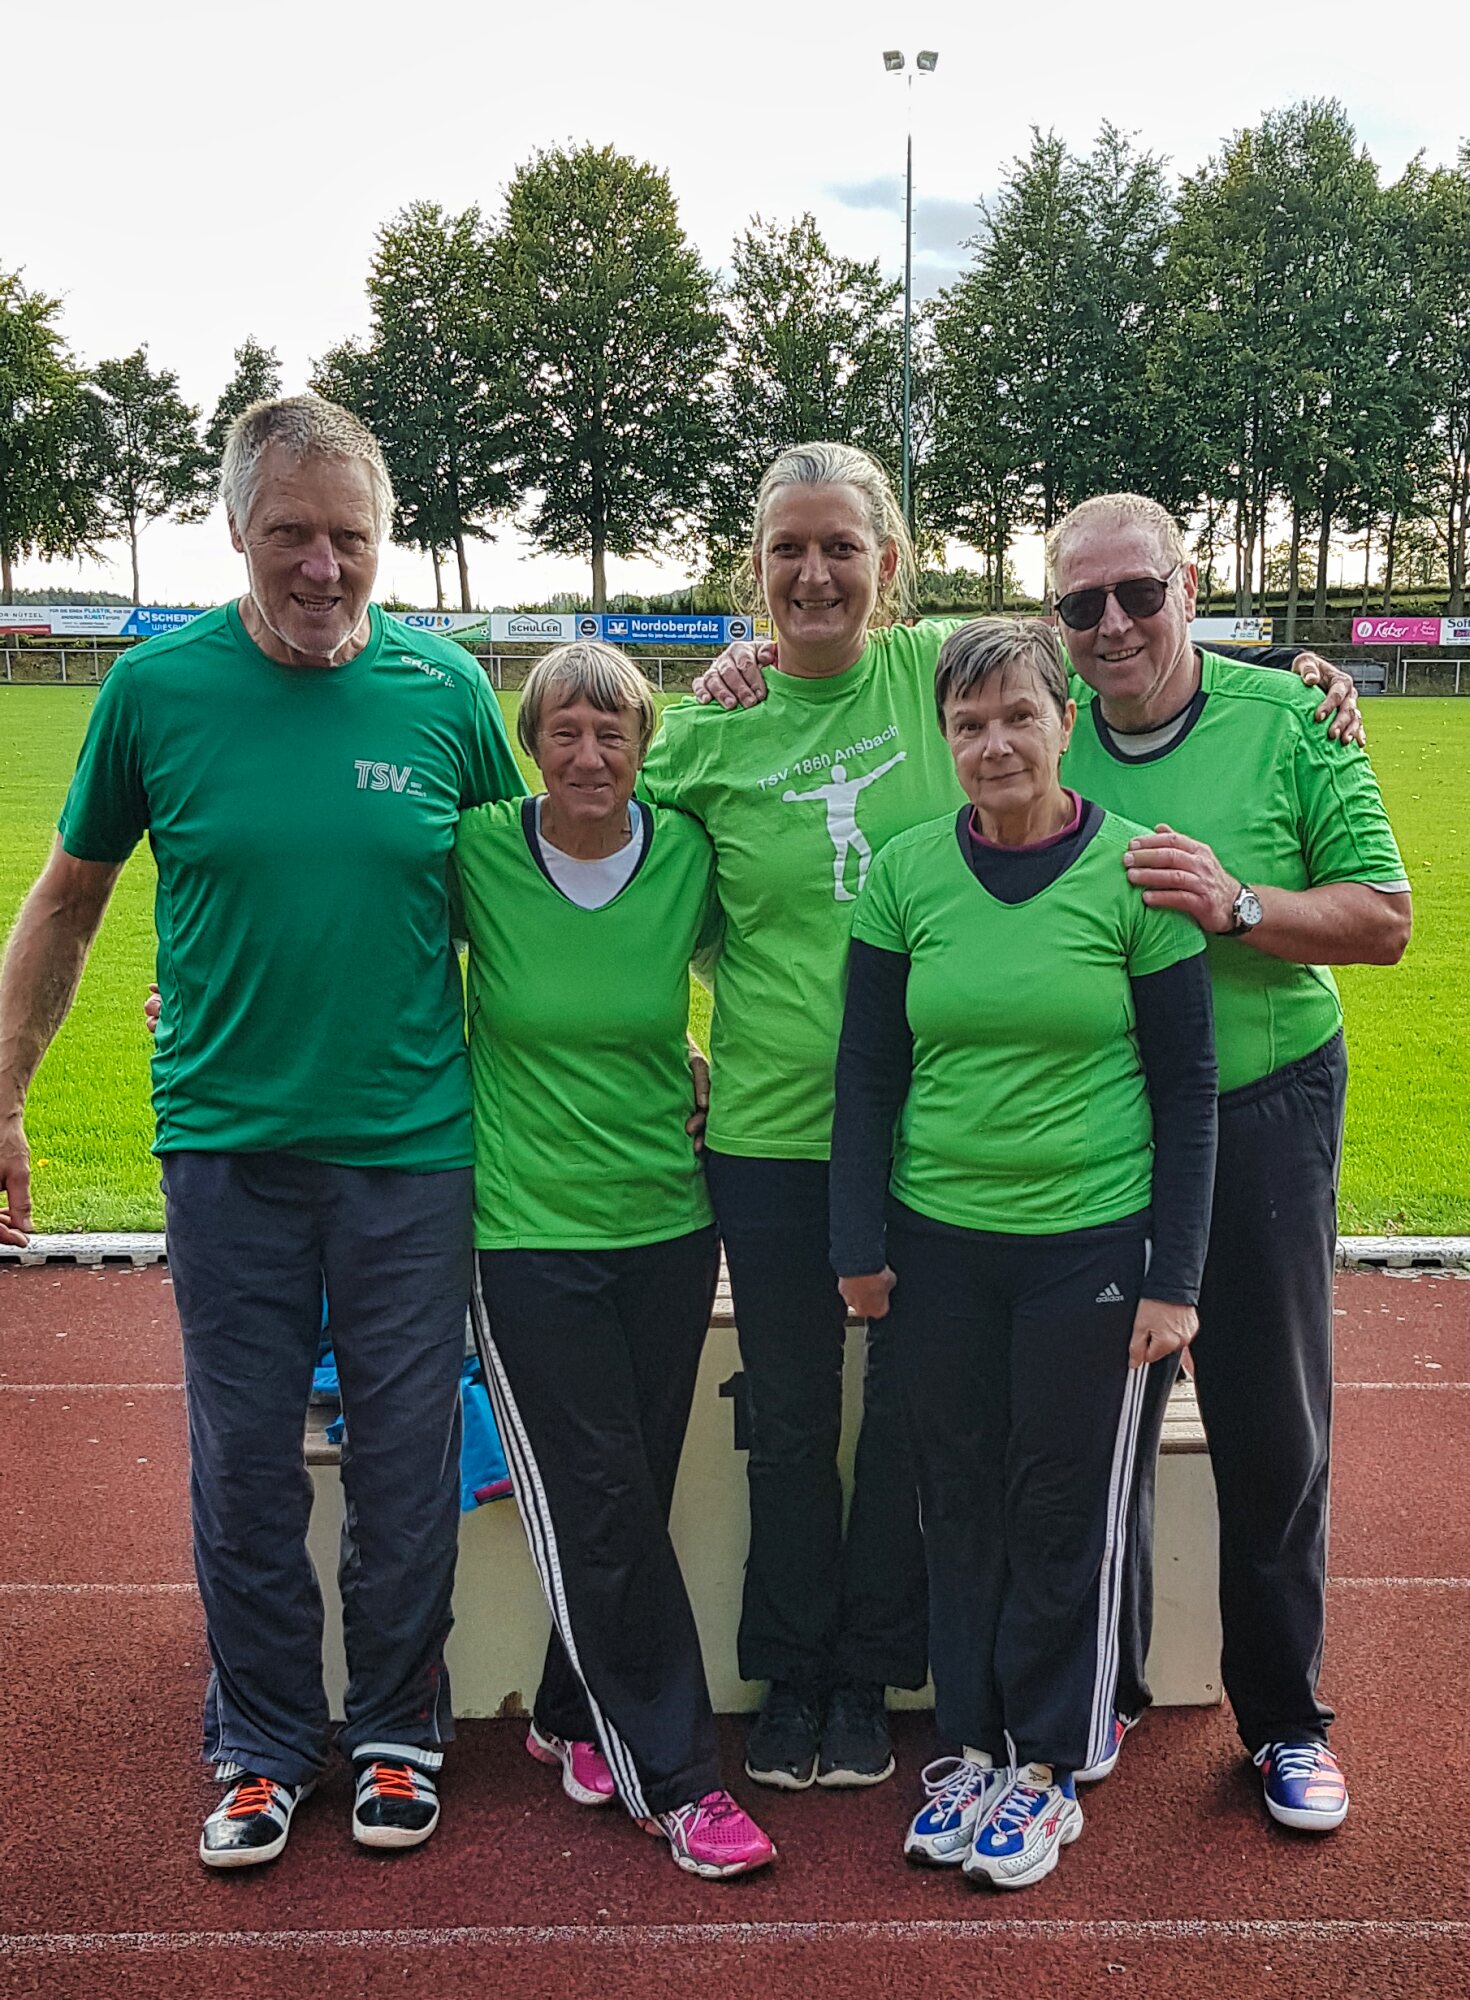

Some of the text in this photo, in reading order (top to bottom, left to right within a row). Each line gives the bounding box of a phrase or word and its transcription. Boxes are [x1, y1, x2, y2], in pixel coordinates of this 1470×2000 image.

[404, 615, 435, 627] CSU
[631, 618, 719, 636] Nordoberpfalz
[400, 655, 447, 681] CRAFT
[793, 754, 832, 776] 1860
[834, 723, 900, 763] Ansbach
[354, 759, 413, 793] TSV
[1095, 1294, 1124, 1303] adidas
